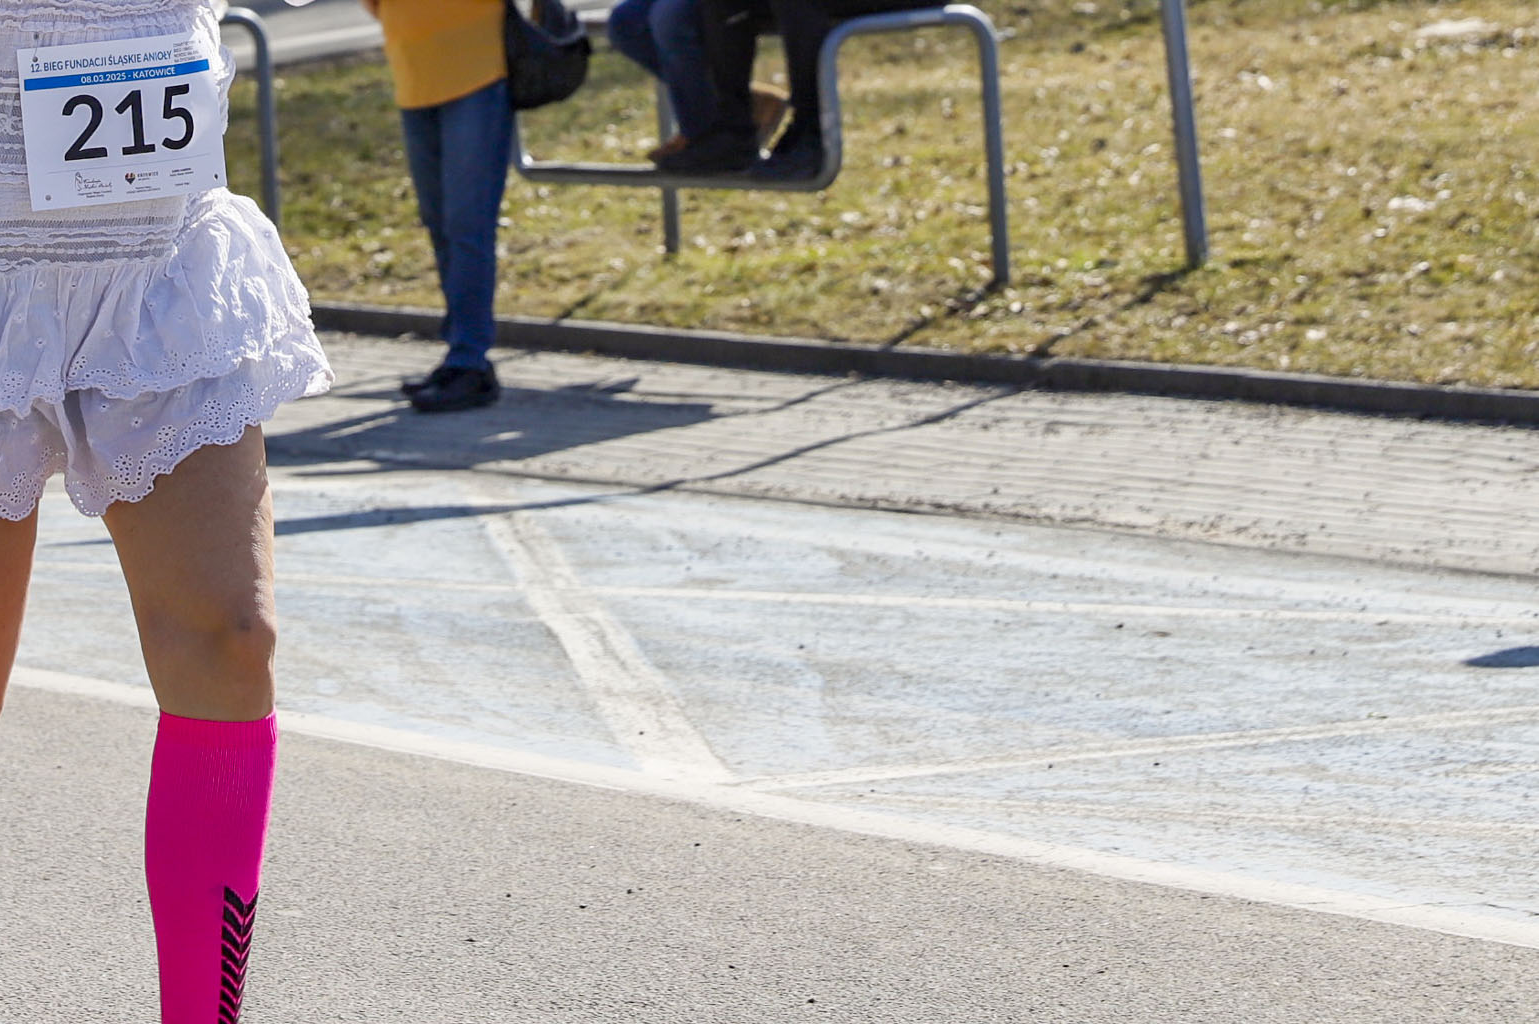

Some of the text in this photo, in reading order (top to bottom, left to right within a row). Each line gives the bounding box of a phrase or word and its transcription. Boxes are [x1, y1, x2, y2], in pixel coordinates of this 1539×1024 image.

[43, 59, 64, 73] BIEG
[64, 57, 108, 70] FUNDACJI
[108, 54, 142, 67] ŚLĄSKIE
[143, 50, 173, 63] ANIOŁY
[80, 71, 127, 85] 08.03.2025
[133, 66, 176, 80] KATOWICE
[62, 83, 195, 162] 215
